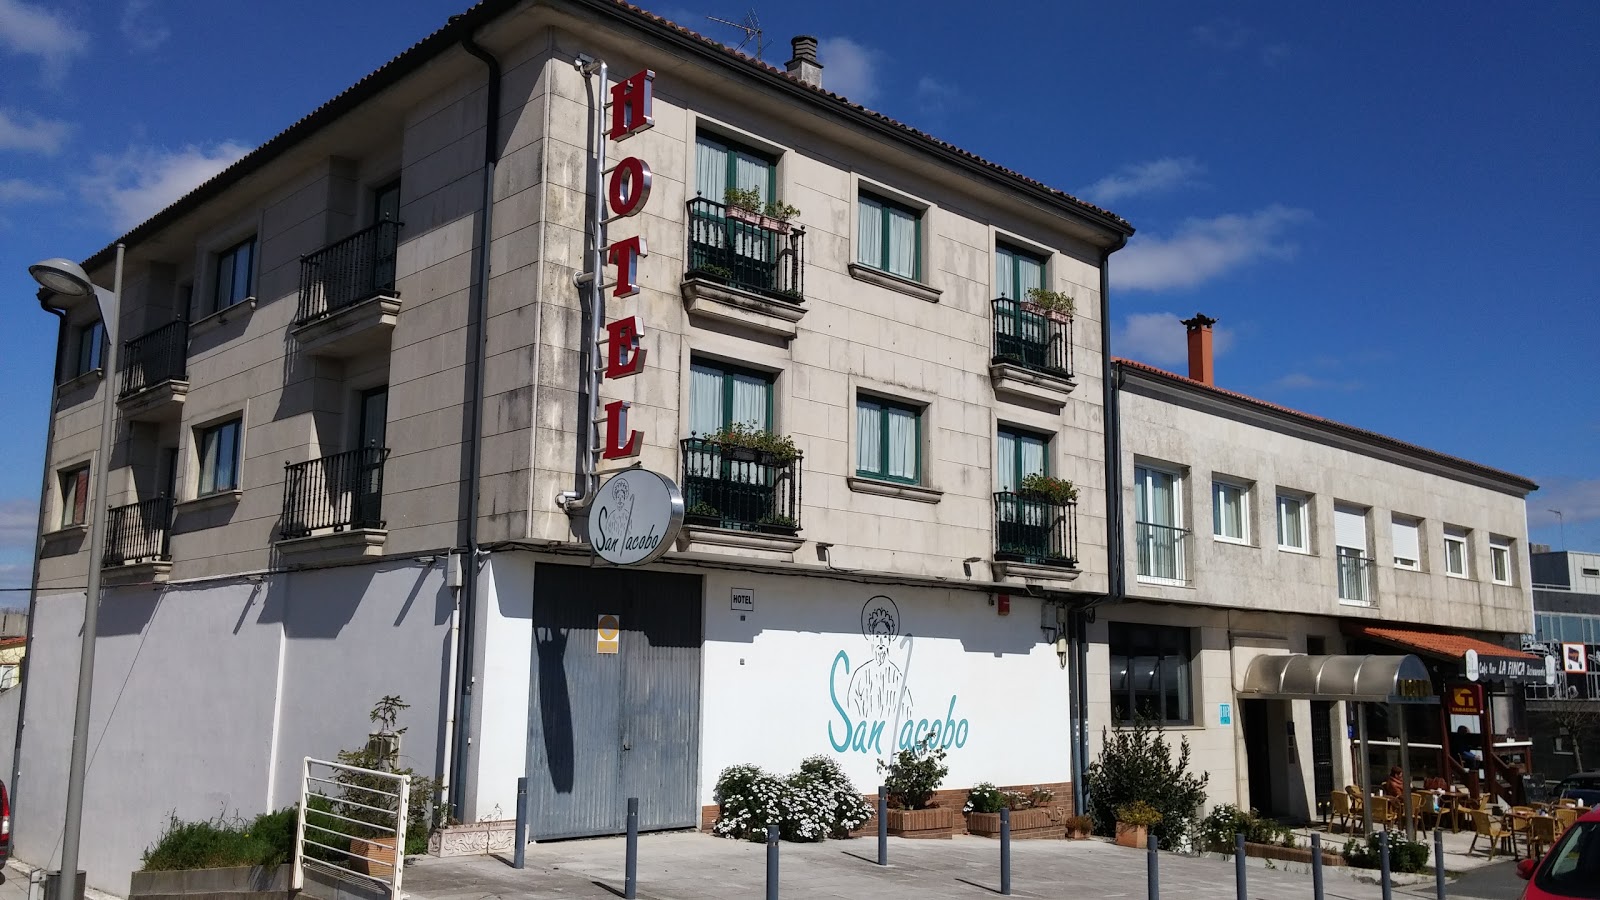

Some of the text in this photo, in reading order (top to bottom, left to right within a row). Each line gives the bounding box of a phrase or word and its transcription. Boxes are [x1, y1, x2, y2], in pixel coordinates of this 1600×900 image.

[603, 69, 655, 459] HOTEL
[596, 506, 619, 552] San
[733, 594, 752, 605] HOTEL
[1498, 660, 1506, 675] LA
[1507, 661, 1525, 676] FINCA
[828, 650, 886, 754] San
